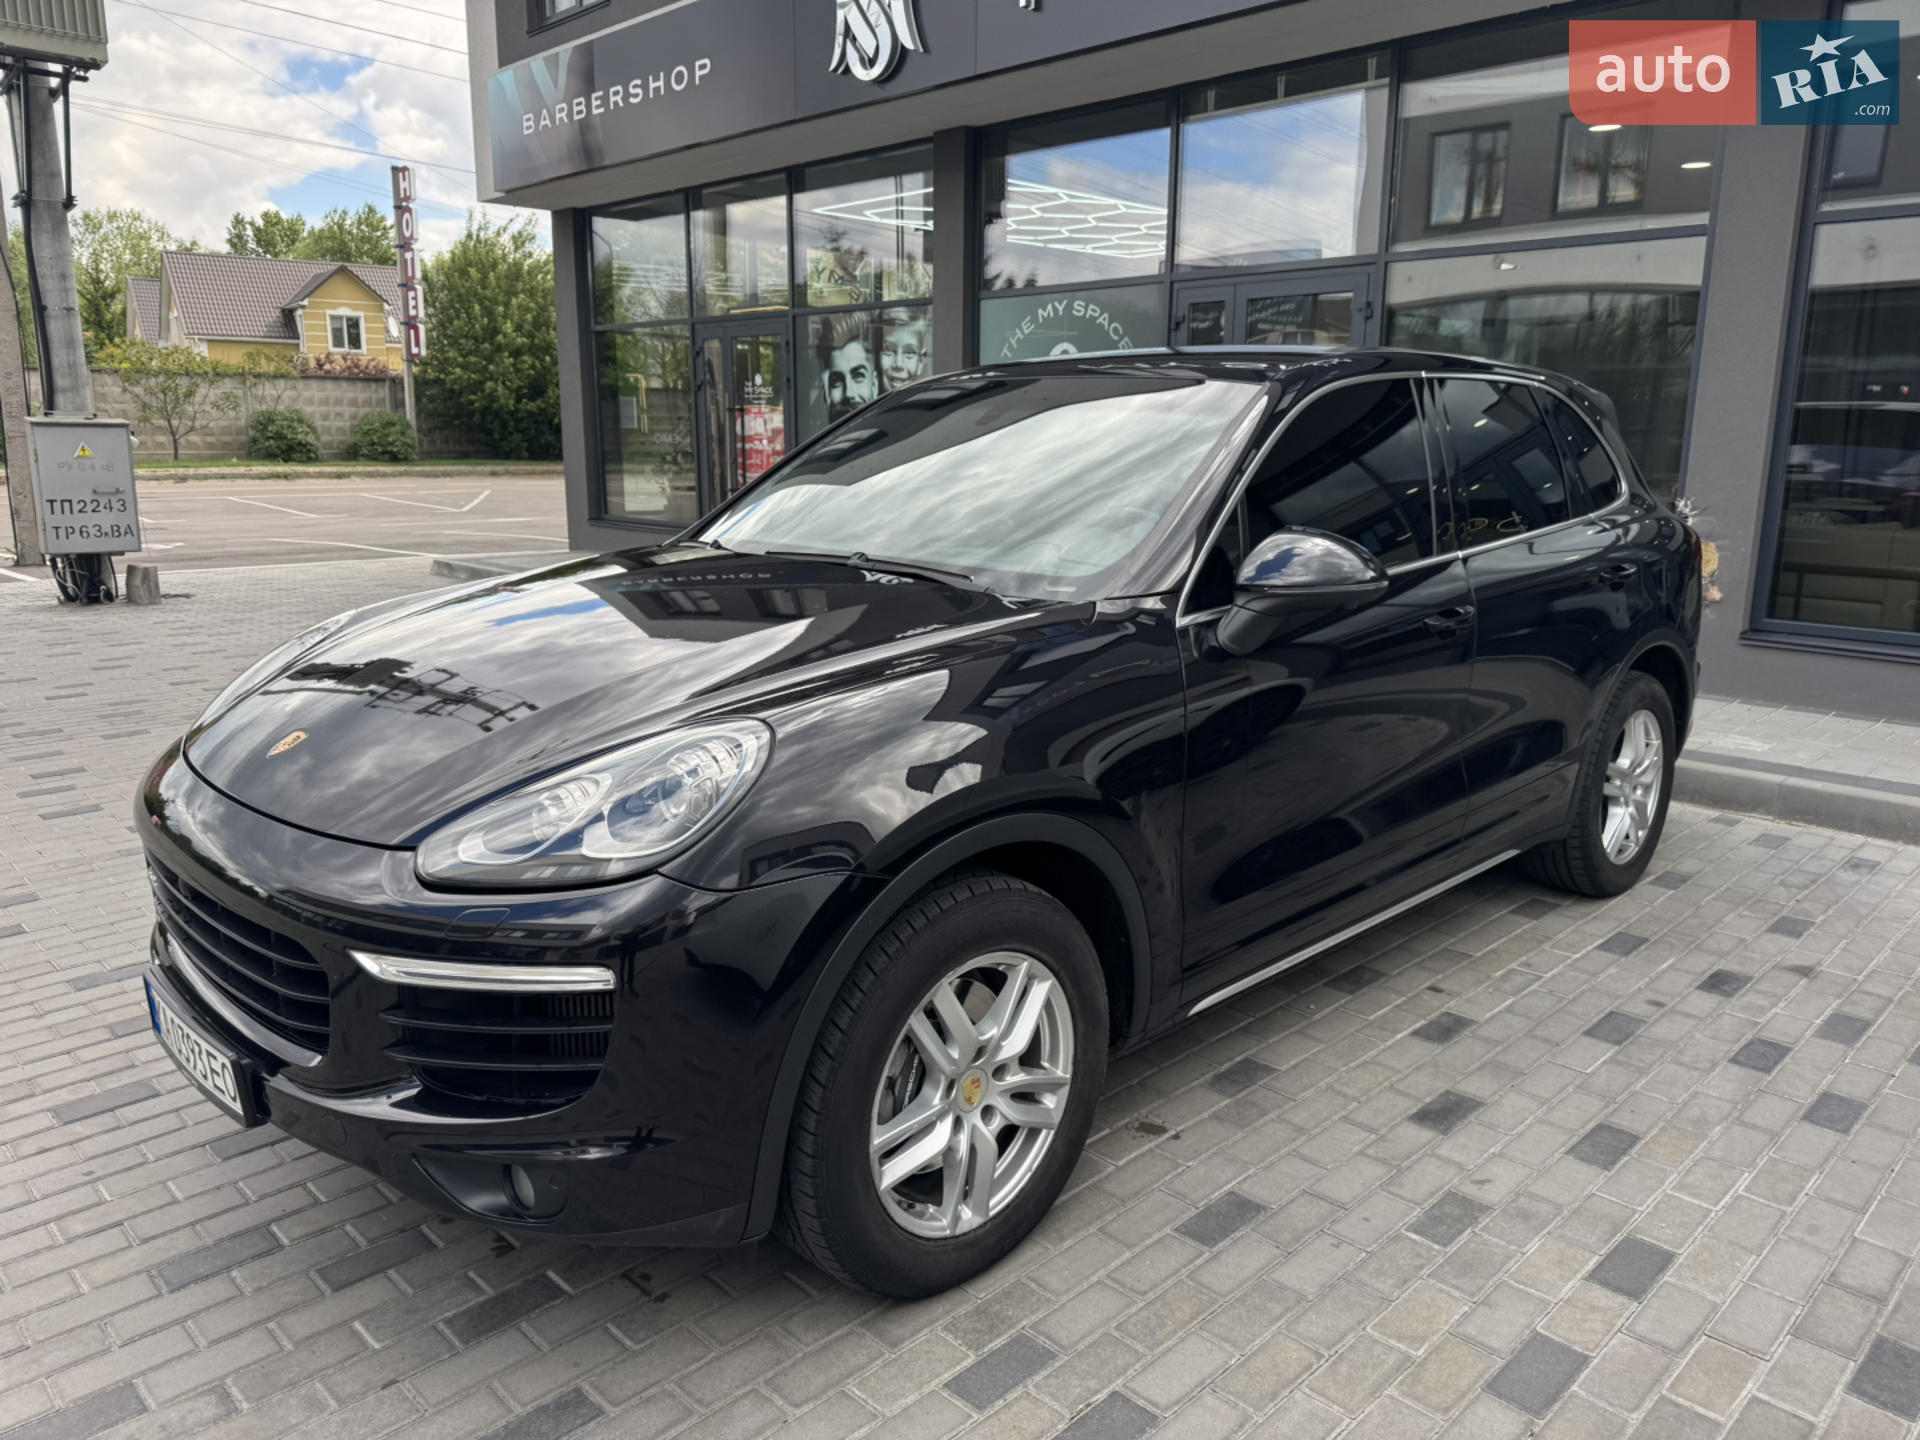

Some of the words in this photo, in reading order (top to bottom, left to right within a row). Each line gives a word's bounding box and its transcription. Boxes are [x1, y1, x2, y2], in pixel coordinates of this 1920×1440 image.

[522, 57, 712, 136] BARBERSHOP
[398, 170, 420, 355] HOTEL
[1000, 316, 1036, 359] THE
[1037, 300, 1068, 323] MY
[1071, 300, 1134, 351] SPACE
